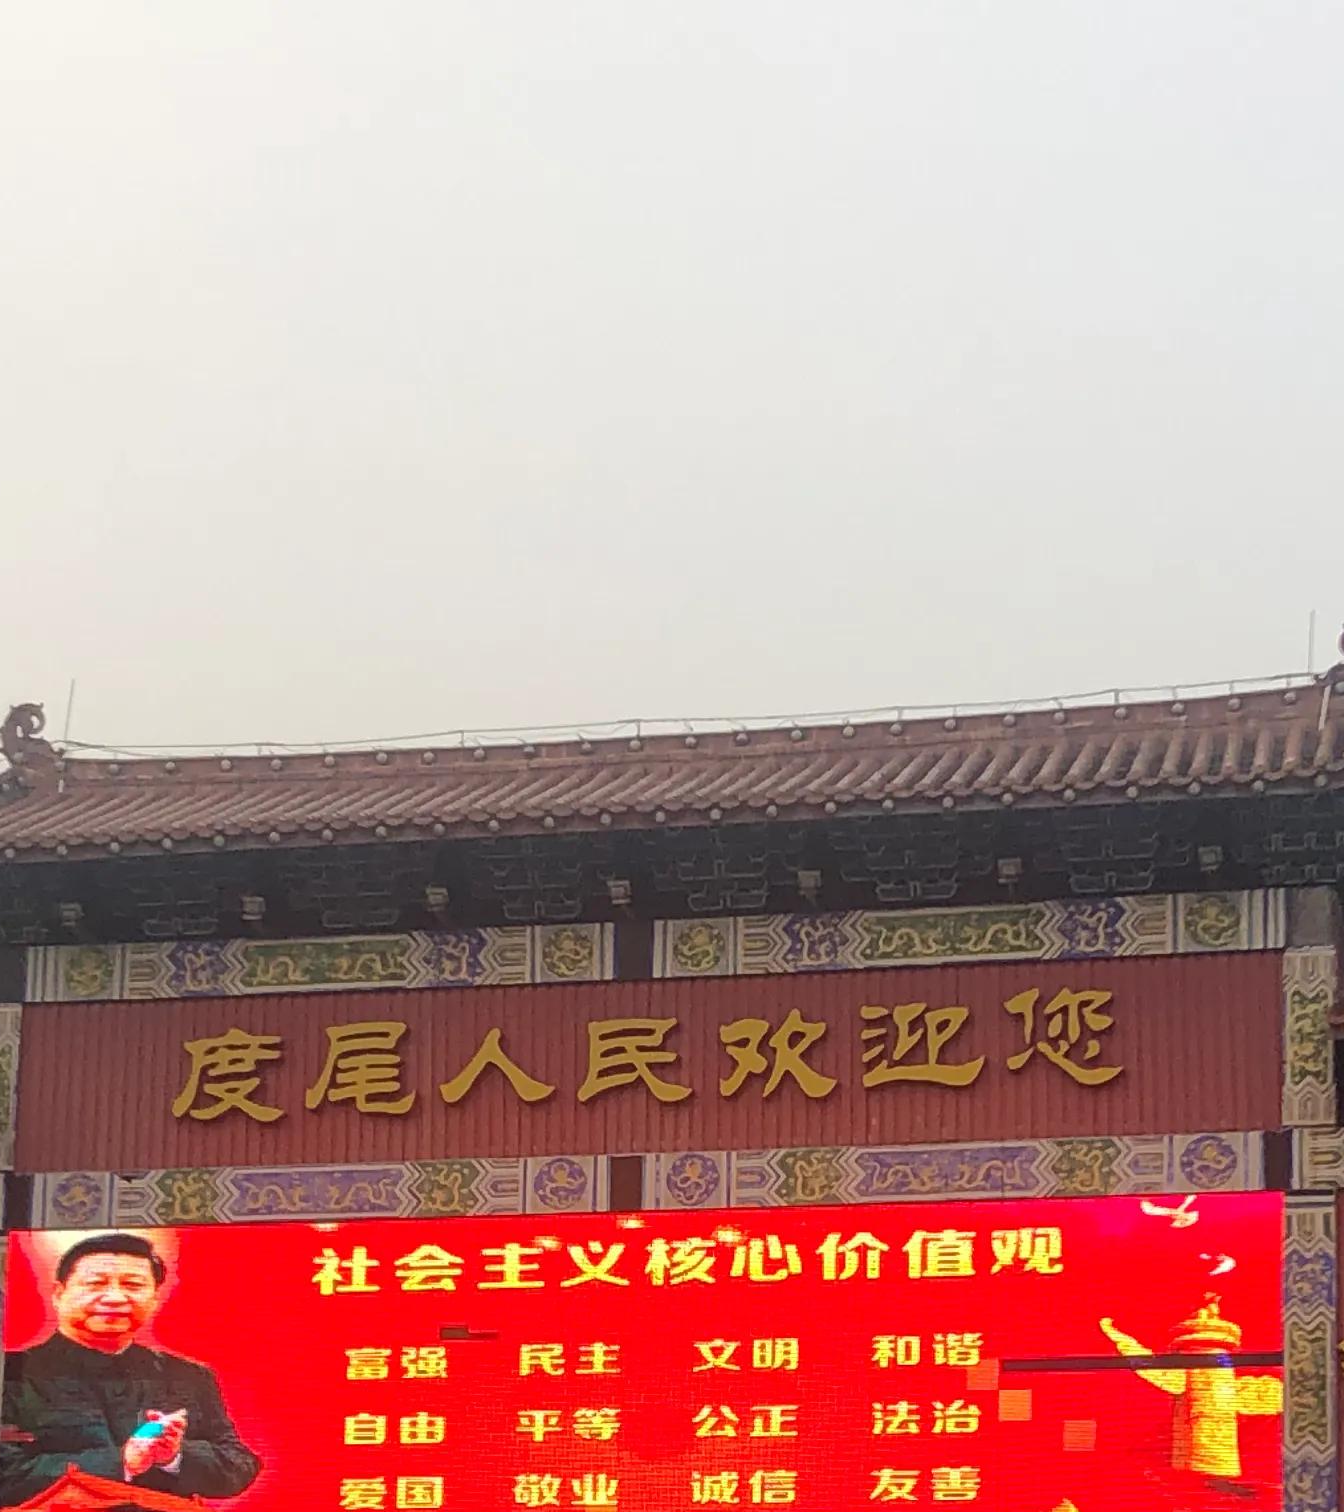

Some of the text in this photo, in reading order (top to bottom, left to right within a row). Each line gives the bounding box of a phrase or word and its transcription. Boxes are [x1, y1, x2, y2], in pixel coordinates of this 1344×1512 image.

[169, 984, 1124, 1123] 度尾人民欢迎您
[310, 1225, 1065, 1296] 社会主义核心价值观
[345, 1331, 984, 1381] 富强 民主 文明 和谐
[343, 1398, 982, 1446] 自由 平等 公正 法治
[338, 1465, 982, 1511] 爱国 敬业 诚信 友善
